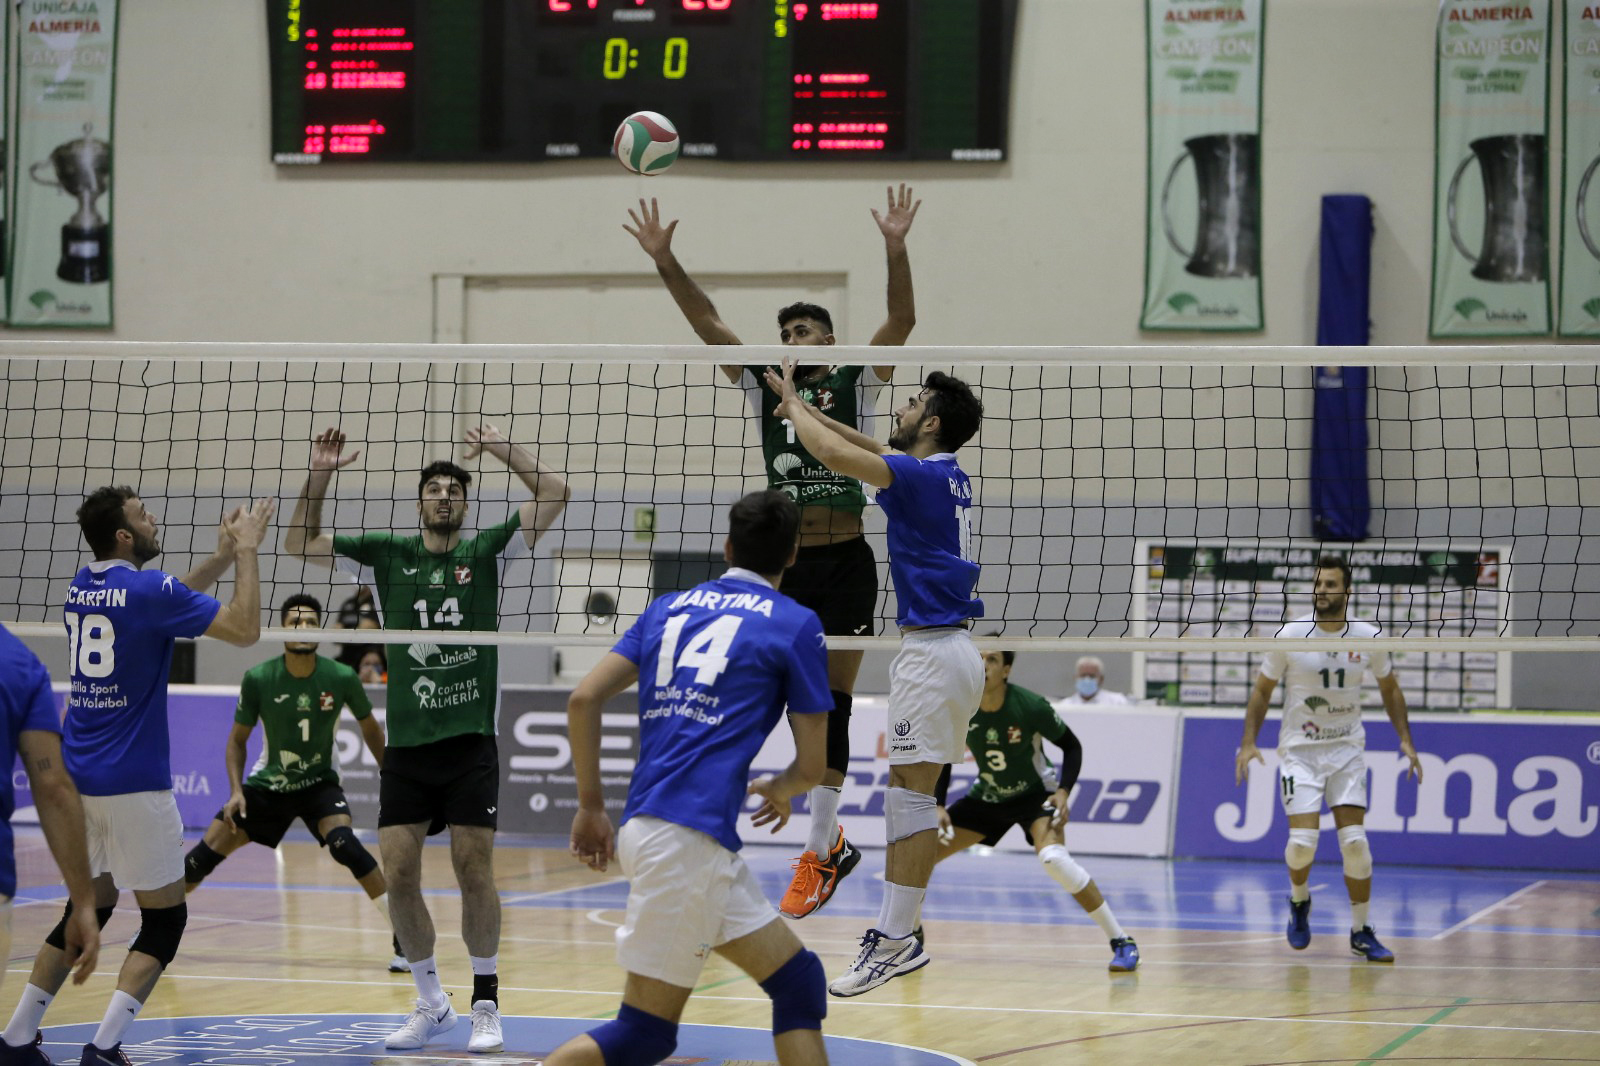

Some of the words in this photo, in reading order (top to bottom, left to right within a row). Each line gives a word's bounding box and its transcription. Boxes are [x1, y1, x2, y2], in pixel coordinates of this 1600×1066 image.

[1449, 5, 1534, 21] ALMERÍA
[413, 597, 463, 628] 14
[65, 612, 116, 678] 18
[440, 646, 478, 664] Unicaja
[655, 613, 744, 687] 14
[438, 681, 465, 696] COSTA
[467, 677, 479, 689] DE
[1318, 668, 1345, 688] 11
[90, 683, 119, 697] Sport
[430, 686, 480, 709] ALMERÍA
[83, 695, 128, 709] Voleibol
[298, 718, 310, 742] 1
[985, 750, 1007, 771] 3
[1213, 747, 1599, 842] Jma
